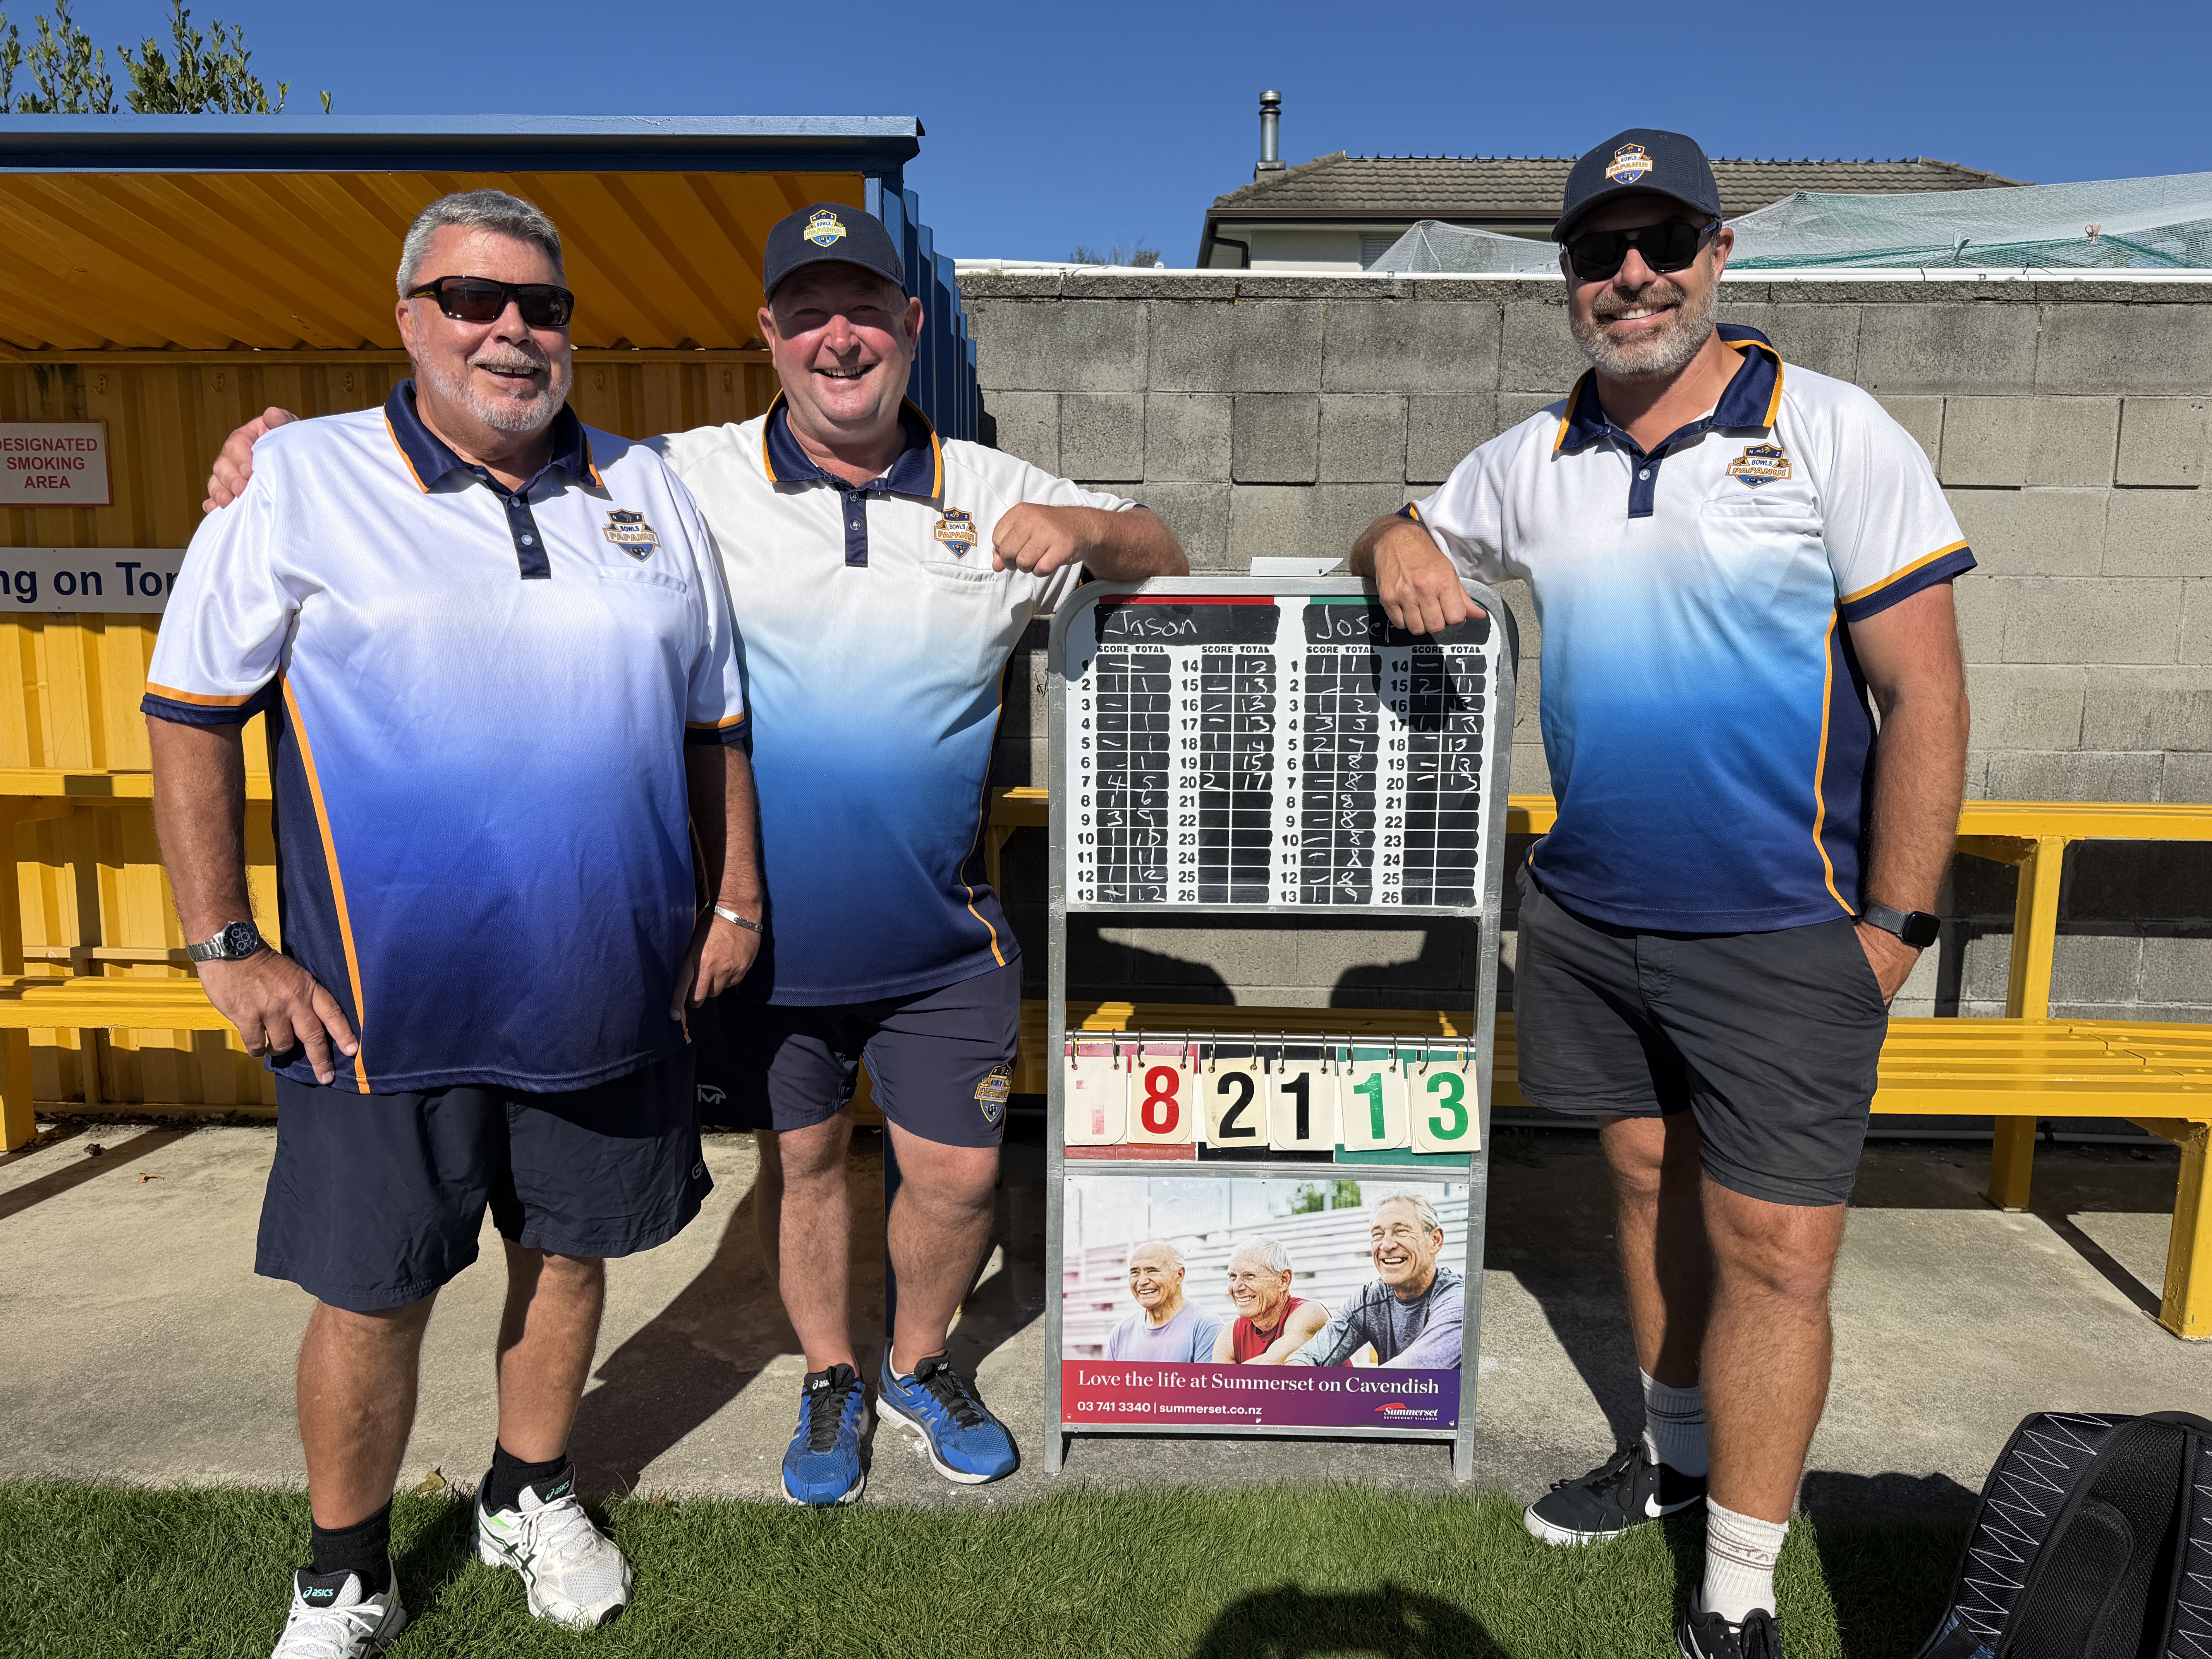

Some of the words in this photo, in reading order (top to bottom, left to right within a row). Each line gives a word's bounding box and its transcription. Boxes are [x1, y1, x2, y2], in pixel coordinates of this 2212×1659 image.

[1609, 162, 1648, 174] PAPANUI
[0, 438, 97, 451] ESIGNATED
[7, 457, 85, 470] SMOKING
[1732, 467, 1786, 476] PAPANUI
[24, 476, 71, 488] AREA
[609, 532, 656, 542] PAPANUI
[938, 531, 974, 542] PAPANUI
[54, 571, 102, 596] on
[1182, 660, 1199, 672] 14
[1244, 660, 1267, 673] 13
[1392, 660, 1408, 672] 14
[1082, 678, 1090, 690] 2
[1182, 679, 1198, 691] 15
[1290, 679, 1298, 692] 2
[1391, 680, 1408, 692] 15
[1082, 699, 1090, 710] 3
[1182, 699, 1198, 711] 16
[1290, 699, 1298, 712] 3
[1353, 699, 1371, 714] 2
[1390, 700, 1407, 712] 16
[1082, 718, 1090, 730] 4
[1181, 718, 1197, 730] 17
[1289, 719, 1297, 731] 4
[1390, 717, 1408, 731] 17
[1449, 716, 1478, 734] 13
[1082, 737, 1090, 749] 5
[1181, 738, 1197, 750] 18
[1288, 738, 1297, 750] 5
[1313, 737, 1334, 752] 2
[1389, 739, 1405, 751] 18
[1448, 738, 1468, 752] 13
[1081, 757, 1090, 768] 6
[1181, 757, 1197, 769] 19
[1243, 753, 1266, 771] 15
[1287, 758, 1296, 770] 6
[1388, 758, 1405, 771] 19
[1451, 754, 1470, 772] 13
[1082, 776, 1090, 787] 7
[1108, 775, 1127, 796] 4
[1134, 776, 1156, 792] 5
[1180, 776, 1197, 788] 20
[1203, 773, 1226, 791] 2
[1245, 773, 1266, 790] 17
[1288, 777, 1296, 789] 7
[1387, 778, 1404, 790] 20
[1081, 795, 1090, 807] 8
[1180, 795, 1194, 807] 21
[1286, 797, 1295, 808] 8
[1340, 794, 1354, 808] 8
[1386, 797, 1401, 809] 21
[1081, 814, 1090, 826] 9
[1107, 811, 1123, 826] 3
[1179, 814, 1196, 826] 22
[1286, 816, 1295, 827] 9
[1340, 811, 1357, 829] 8
[1385, 816, 1402, 828] 22
[1078, 833, 1094, 845] 10
[1179, 833, 1195, 845] 23
[1282, 835, 1298, 846] 10
[1384, 835, 1401, 847] 23
[1078, 852, 1092, 863] 11
[1179, 852, 1195, 864] 24
[1282, 854, 1296, 864] 11
[1384, 854, 1400, 866] 24
[1078, 870, 1094, 882] 12
[1138, 866, 1164, 883] 12
[1179, 871, 1195, 883] 25
[1281, 872, 1297, 884] 12
[1383, 873, 1399, 884] 25
[1078, 889, 1094, 901] 13
[1178, 890, 1195, 901] 26
[1281, 891, 1297, 902] 13
[1382, 891, 1399, 903] 26
[1078, 1370, 1120, 1386] Love
[1125, 1371, 1153, 1387] the
[1158, 1372, 1186, 1388] life
[1190, 1375, 1207, 1388] at
[1212, 1373, 1315, 1391] Summerset
[1318, 1380, 1340, 1392] on
[1346, 1377, 1439, 1394] Cavendish
[1077, 1401, 1094, 1411] 03
[1096, 1402, 1115, 1412] 741
[1118, 1403, 1151, 1413] 3340
[1159, 1405, 1262, 1415] summerset.co.nz
[1384, 1407, 1438, 1416] Summerset
[312, 1589, 333, 1597] asics
